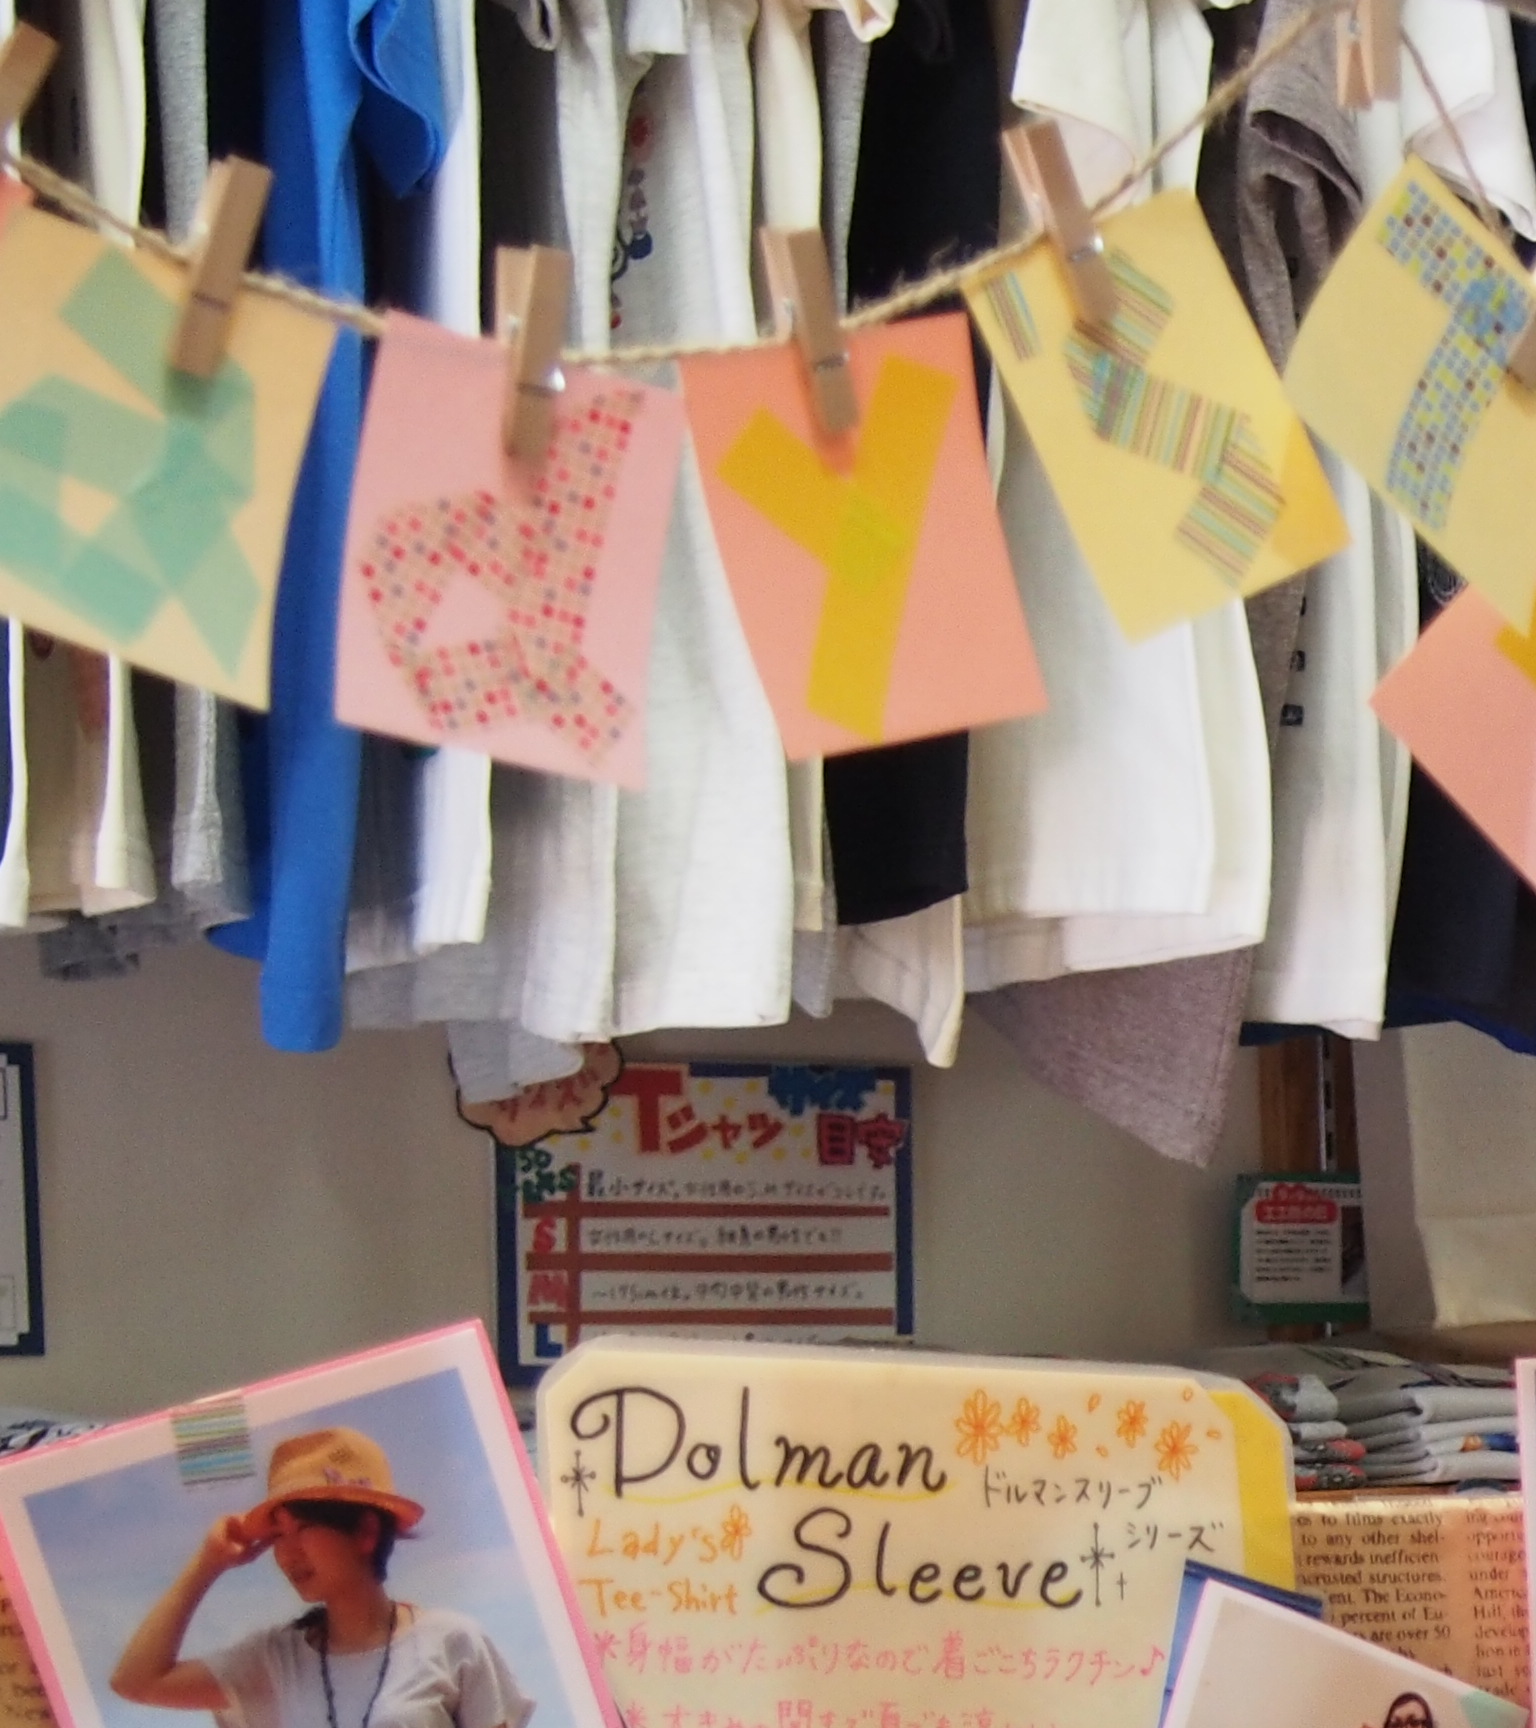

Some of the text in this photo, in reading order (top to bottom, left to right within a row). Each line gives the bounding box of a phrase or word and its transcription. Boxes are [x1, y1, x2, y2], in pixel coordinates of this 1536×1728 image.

[569, 1386, 949, 1499] Dolman
[983, 1473, 1164, 1510] ドルマンスリーブ
[586, 1518, 718, 1564] Lady's
[757, 1506, 1086, 1611] Sleeve
[1125, 1520, 1227, 1554] シリーズ
